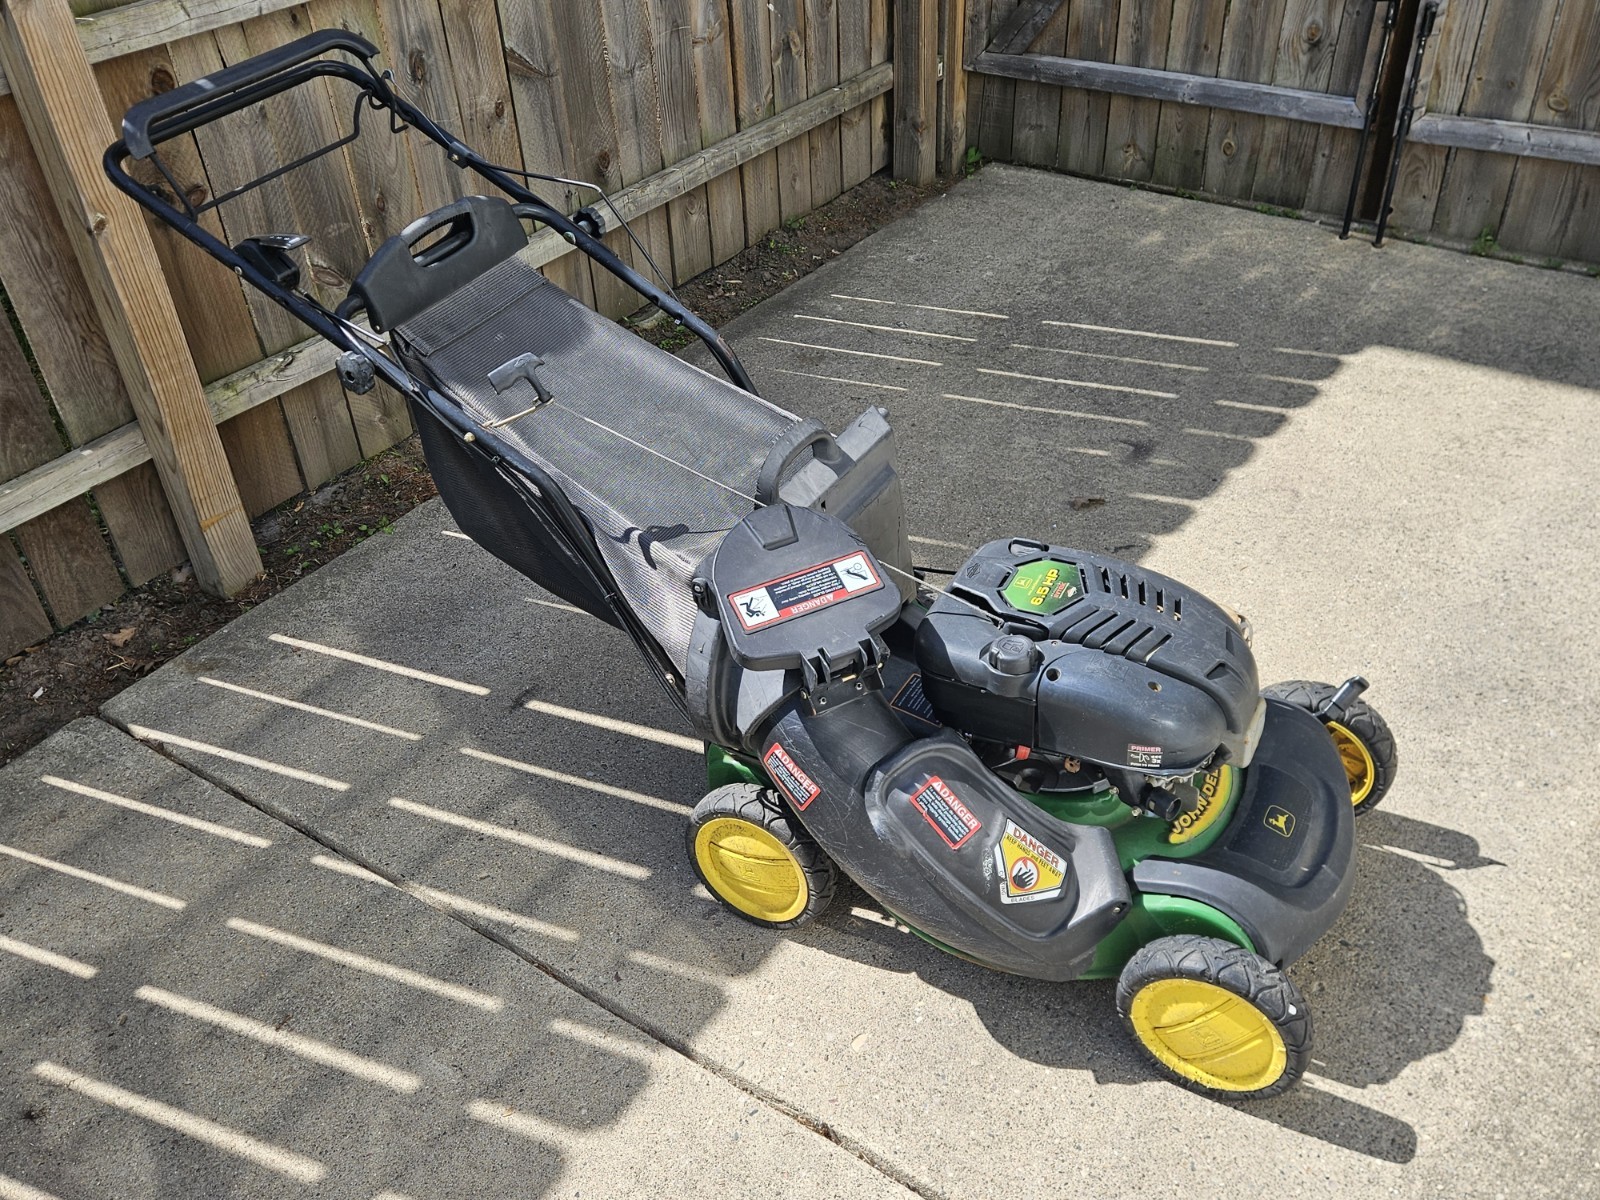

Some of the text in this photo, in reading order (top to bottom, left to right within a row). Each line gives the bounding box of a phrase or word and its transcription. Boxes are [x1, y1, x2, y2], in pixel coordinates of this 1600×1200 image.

[789, 595, 827, 614] DANGER
[1030, 586, 1051, 606] 6.5
[1042, 568, 1060, 586] HP
[781, 756, 817, 794] DANGER
[939, 786, 978, 830] DANGER
[1172, 795, 1208, 834] JOHN
[1006, 834, 1017, 846] KEEP
[1013, 827, 1060, 868] DANGER
[1010, 895, 1036, 903] BLADES
